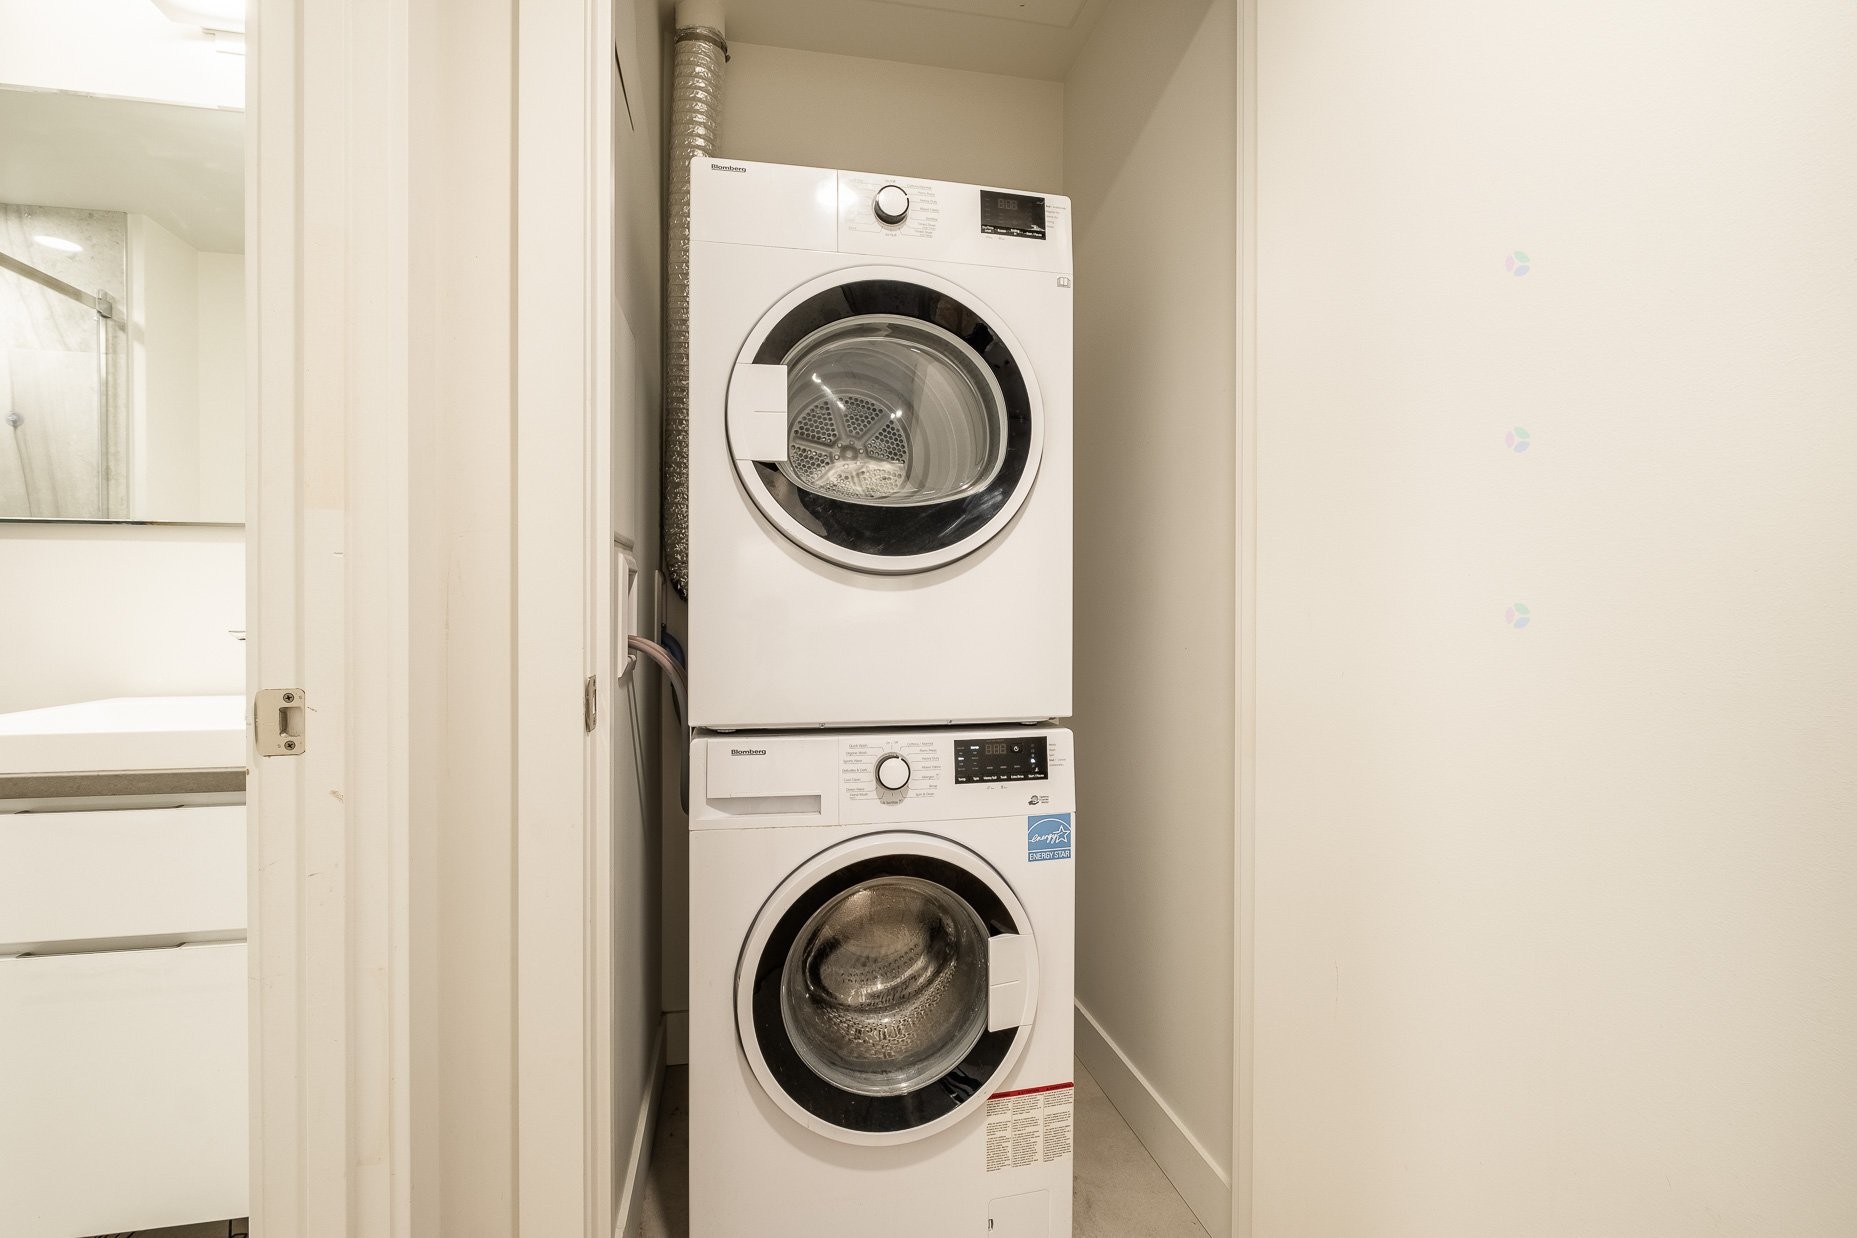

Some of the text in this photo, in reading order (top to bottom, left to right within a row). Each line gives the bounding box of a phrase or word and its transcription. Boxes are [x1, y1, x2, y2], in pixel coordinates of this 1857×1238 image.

[711, 163, 747, 173] Blomberg
[730, 749, 767, 757] Blomberg
[1029, 833, 1058, 844] energy
[1029, 850, 1070, 861] ENERGY STAR
